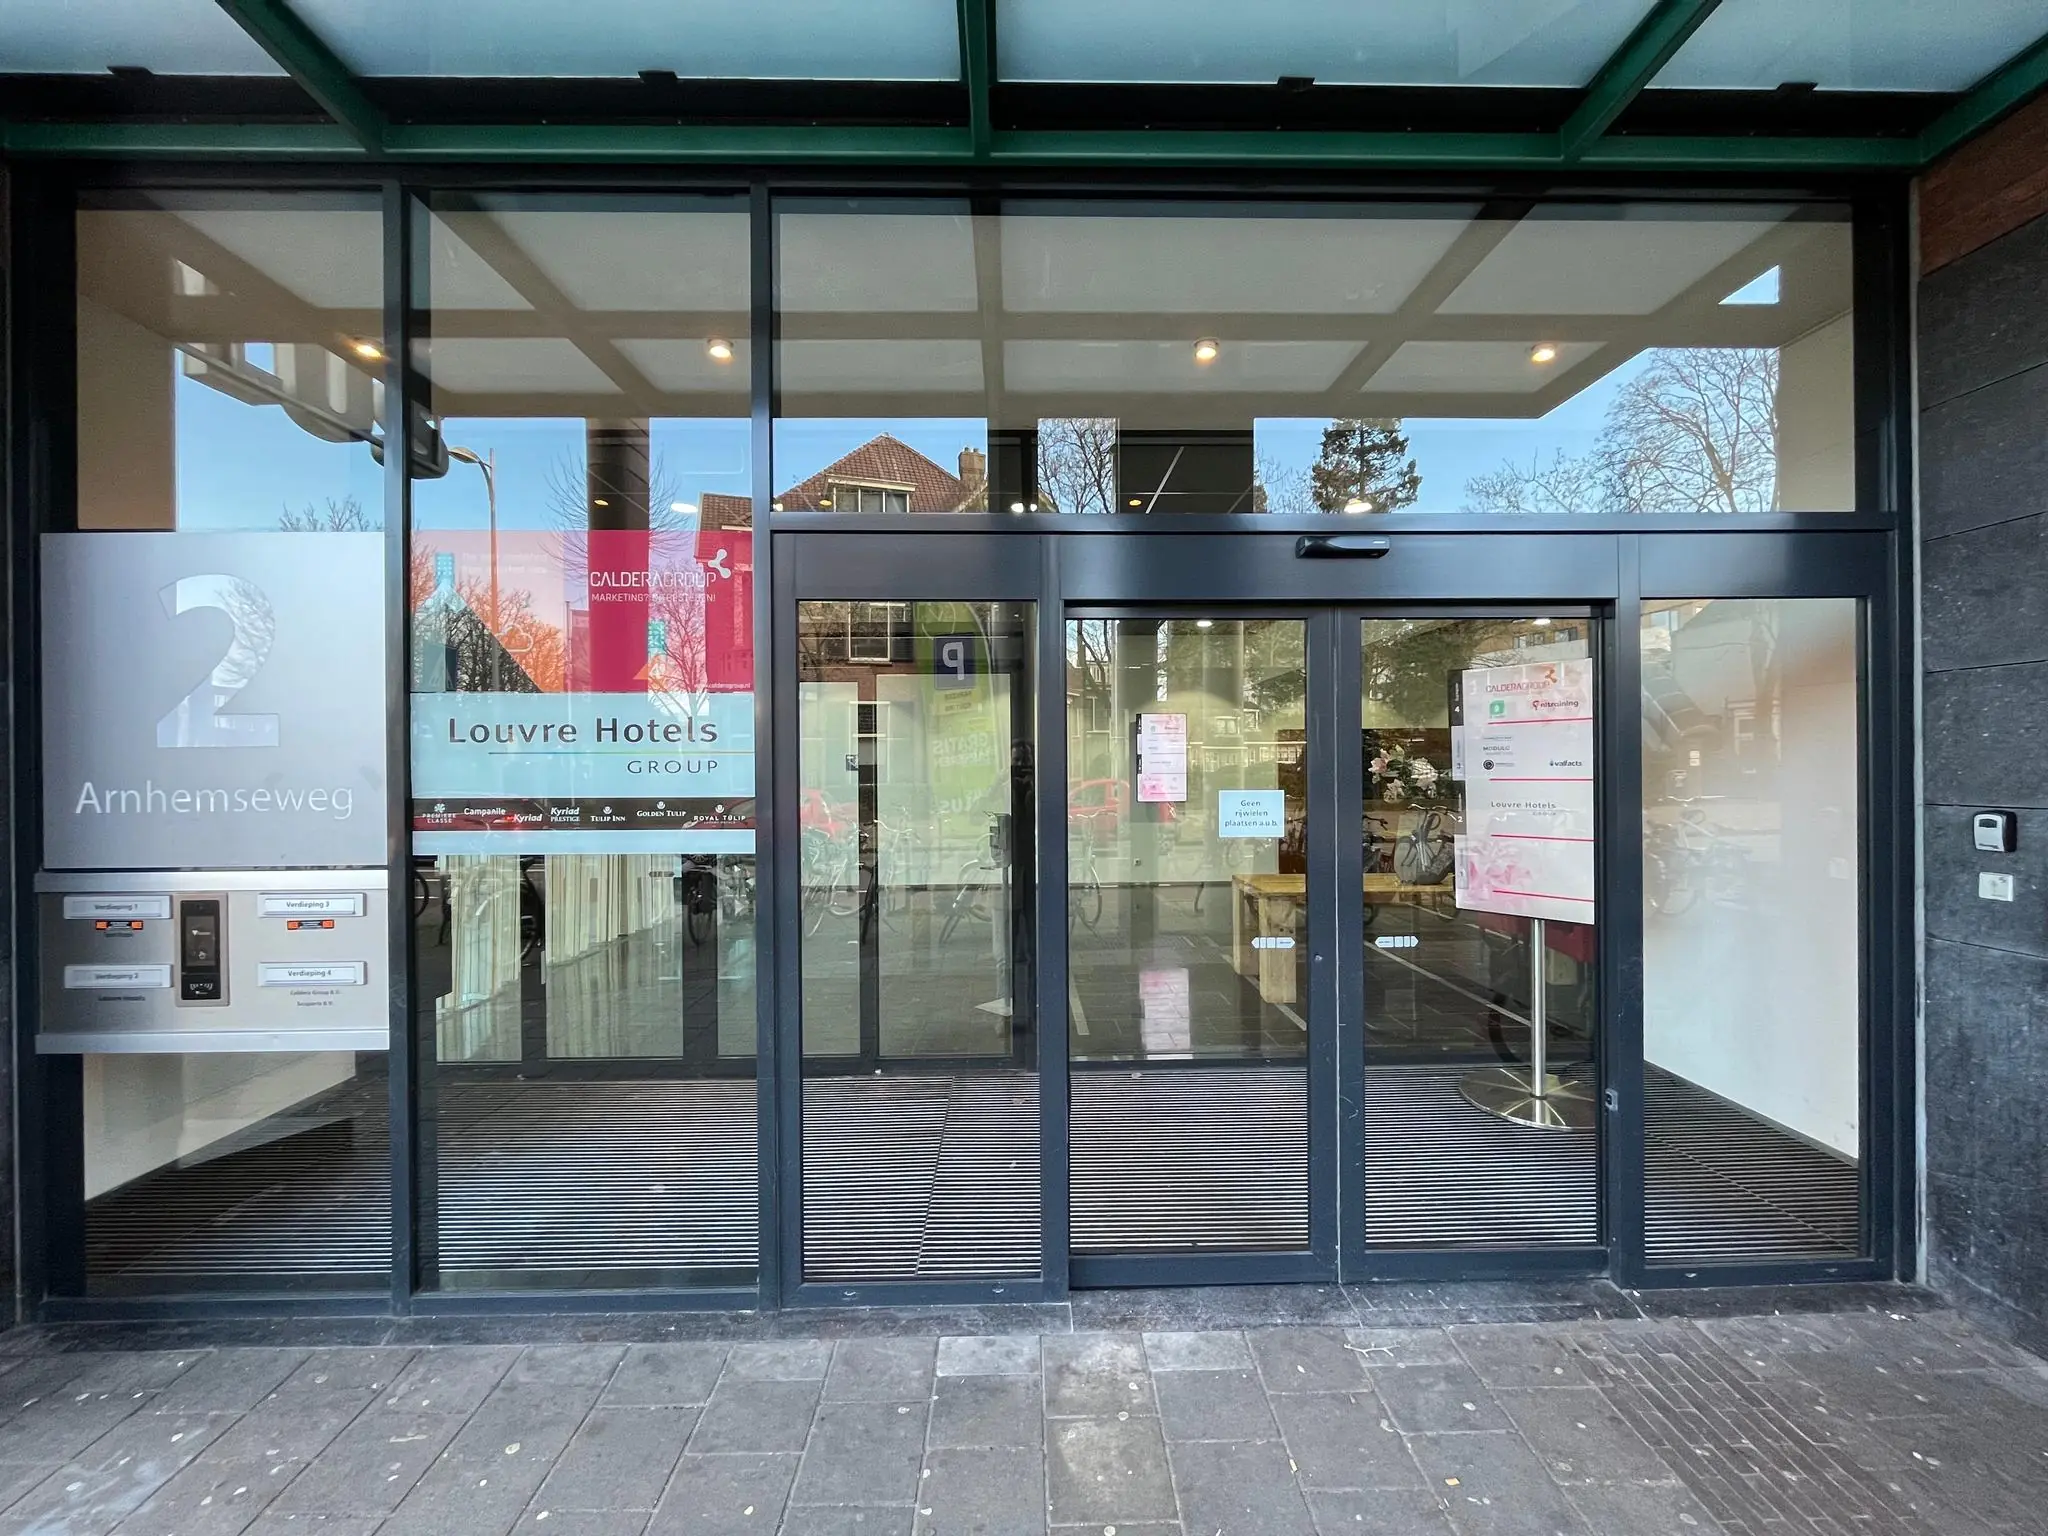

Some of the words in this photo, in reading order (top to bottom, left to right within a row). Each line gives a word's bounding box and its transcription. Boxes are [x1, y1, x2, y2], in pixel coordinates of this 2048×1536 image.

[590, 571, 717, 587] CALDERAGROUP
[591, 593, 649, 602] MARKETING?
[157, 574, 280, 748] 2
[1485, 681, 1551, 693] CALDERAGROUP
[449, 718, 577, 743] Louvre
[596, 716, 718, 743] Hotels
[627, 760, 718, 774] GROUP
[75, 780, 353, 820] Arnhemseweg
[463, 807, 507, 817] Campanile
[551, 807, 580, 817] Kyriad
[1235, 809, 1268, 817] rijwielen
[513, 813, 542, 822] Kyriad
[1224, 819, 1257, 827] plaatsen
[287, 968, 326, 976] Verdieping
